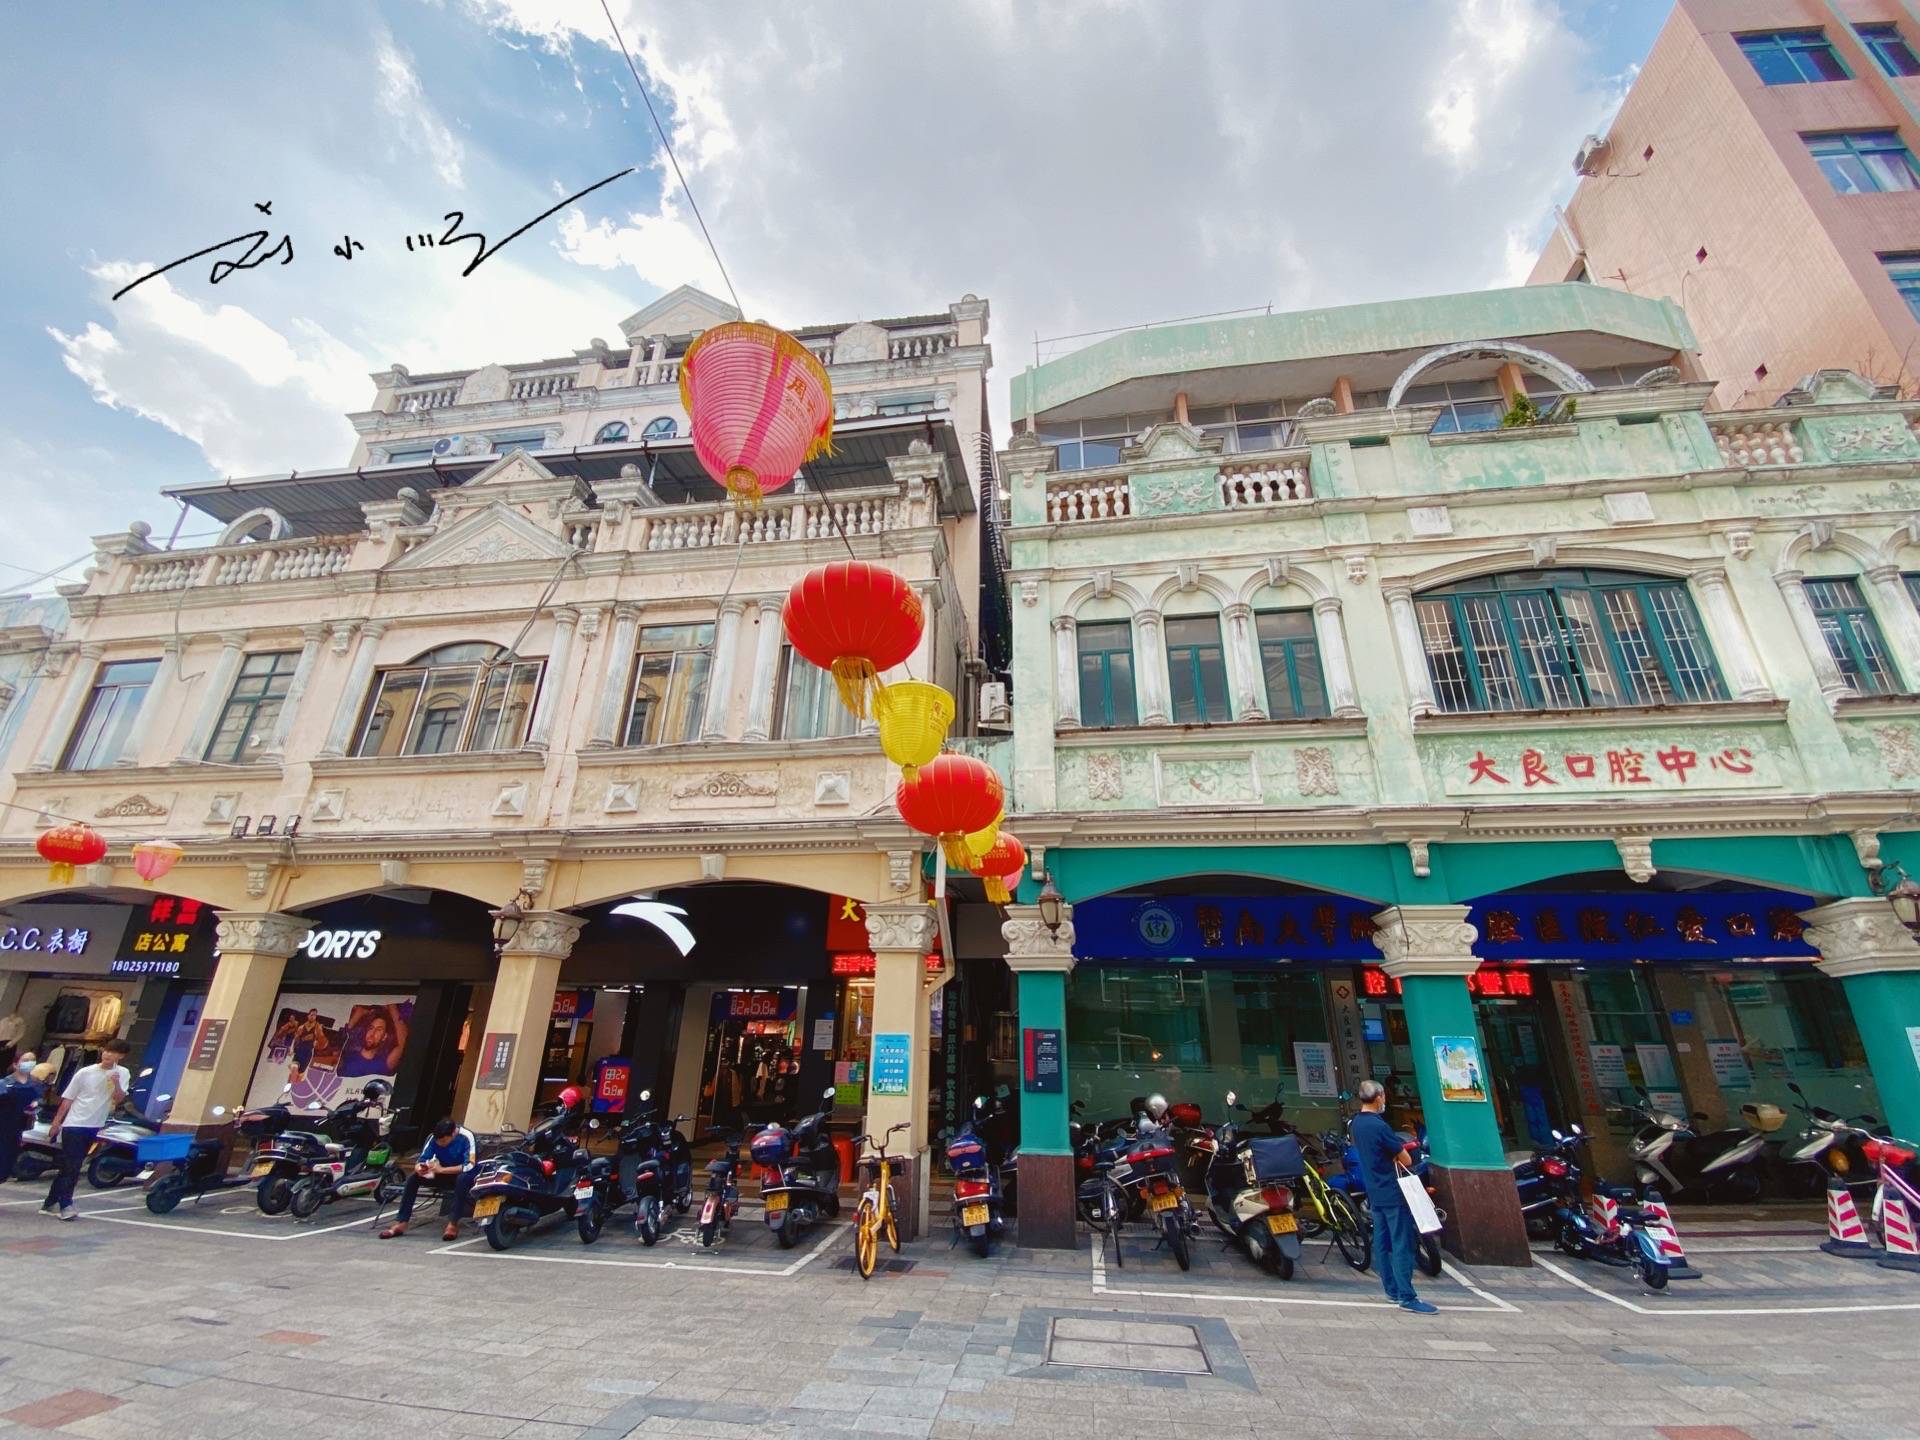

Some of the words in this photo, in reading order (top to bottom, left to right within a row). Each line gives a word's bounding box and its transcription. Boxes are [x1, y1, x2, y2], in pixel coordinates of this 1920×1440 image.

[1468, 744, 1754, 787] 大良口腔中心
[840, 897, 860, 921] 大
[135, 933, 190, 953] 店公寓
[111, 960, 180, 973] 18025971180
